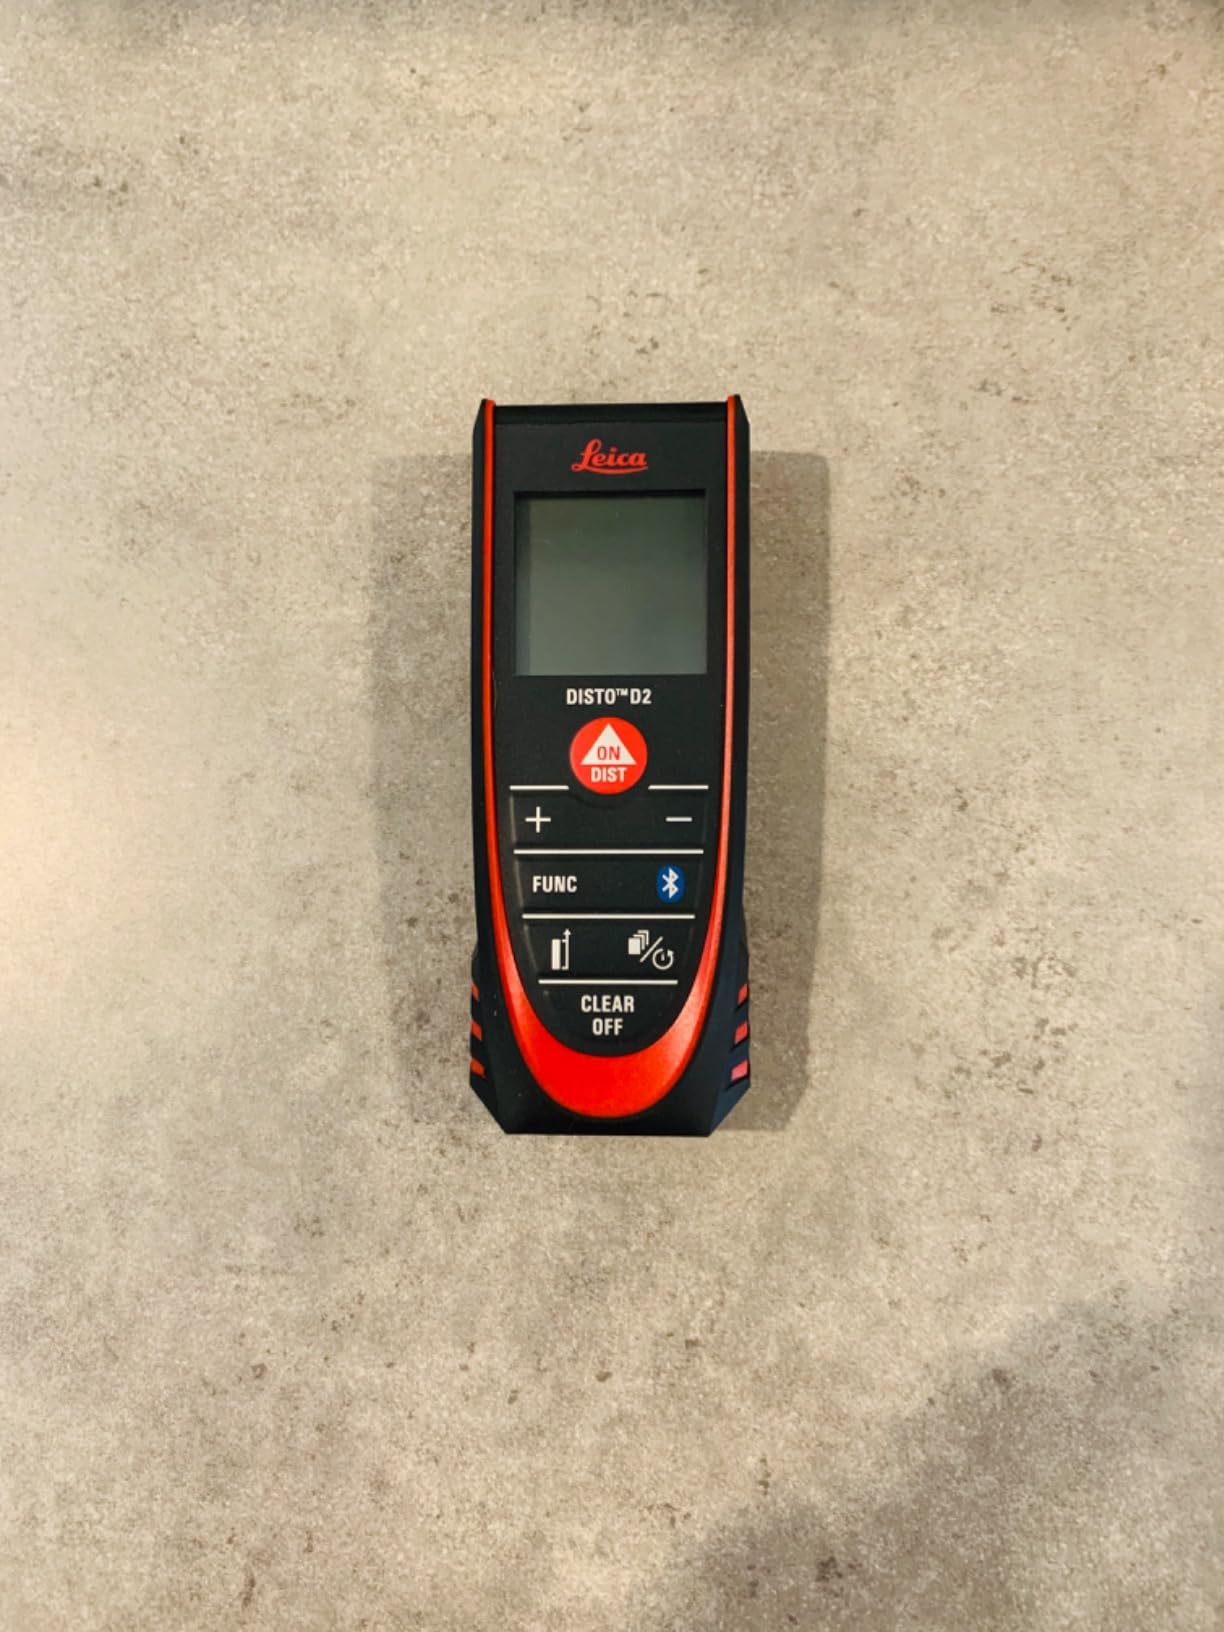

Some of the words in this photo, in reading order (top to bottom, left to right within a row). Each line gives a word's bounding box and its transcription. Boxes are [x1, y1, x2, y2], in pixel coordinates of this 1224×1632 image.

[571, 438, 648, 474] Leica
[630, 687, 653, 705] D2
[597, 745, 621, 761] ON
[590, 766, 627, 783] DIST
[532, 875, 578, 893] FUNC
[580, 994, 635, 1013] CLEAR
[592, 1017, 624, 1036] OFF
